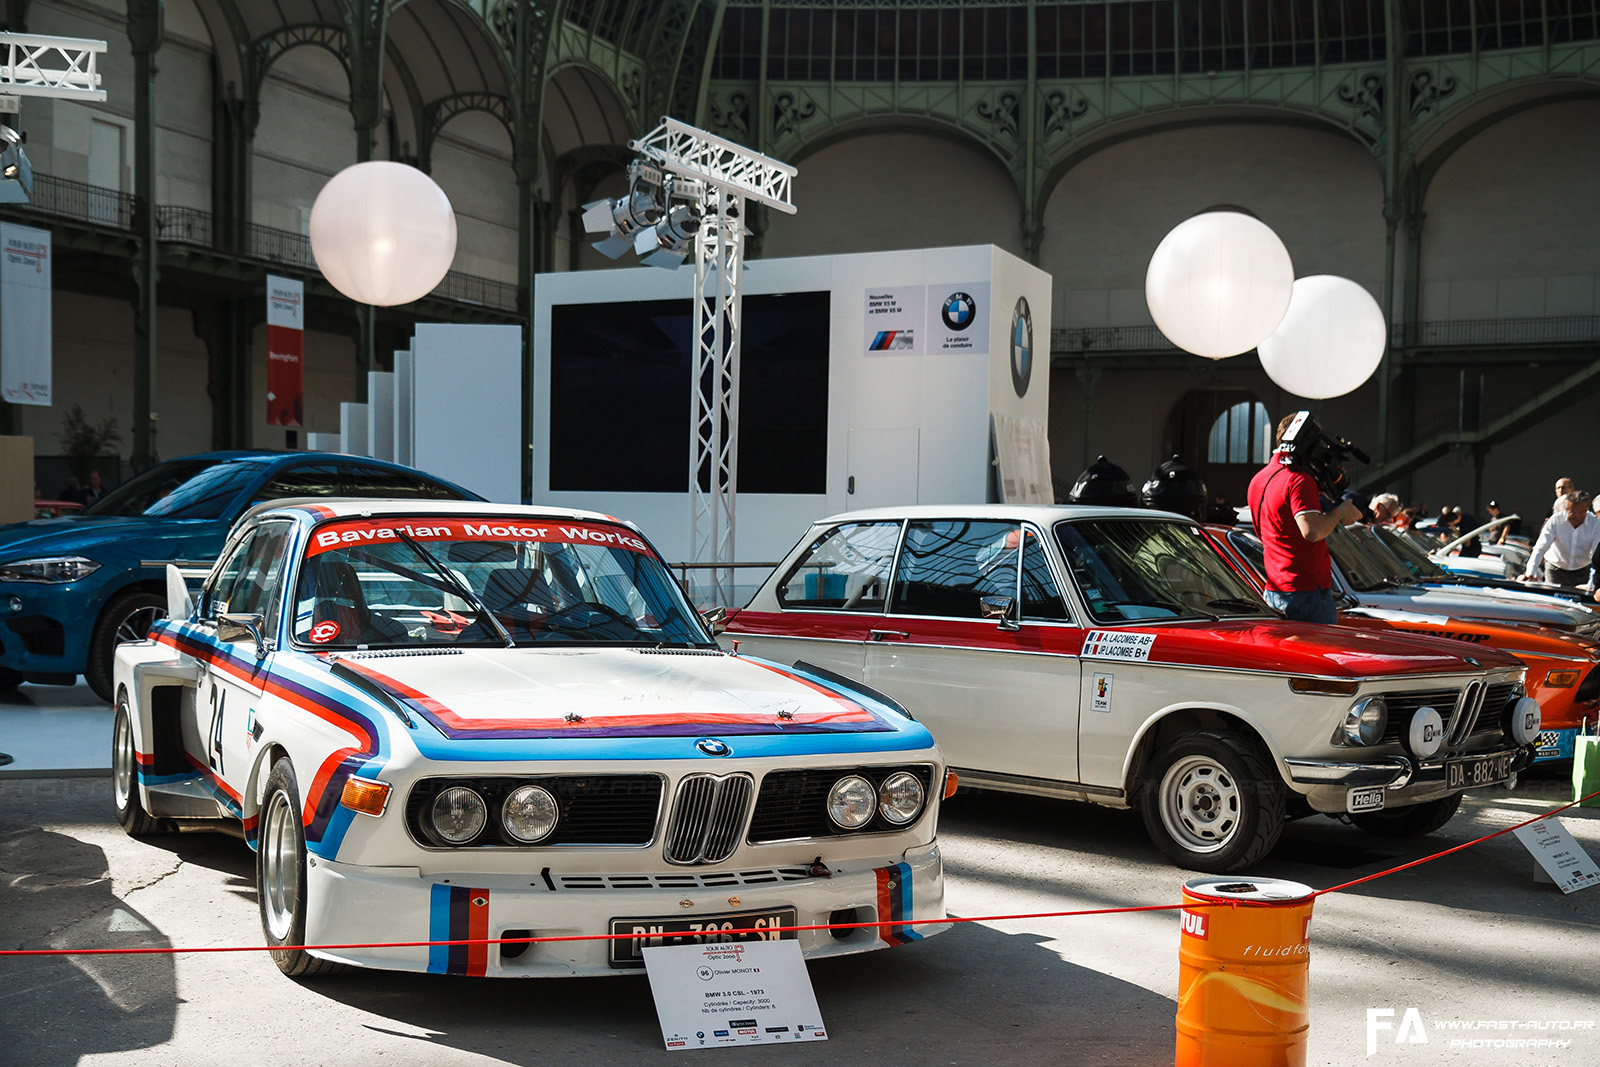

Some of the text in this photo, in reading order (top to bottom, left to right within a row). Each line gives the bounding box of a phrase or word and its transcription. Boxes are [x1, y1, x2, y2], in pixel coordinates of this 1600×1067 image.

[316, 524, 647, 551] Bavarian Motor Works
[208, 683, 227, 777] 24
[1450, 764, 1465, 787] DA
[1473, 760, 1494, 783] 882
[1355, 793, 1382, 806] Hella
